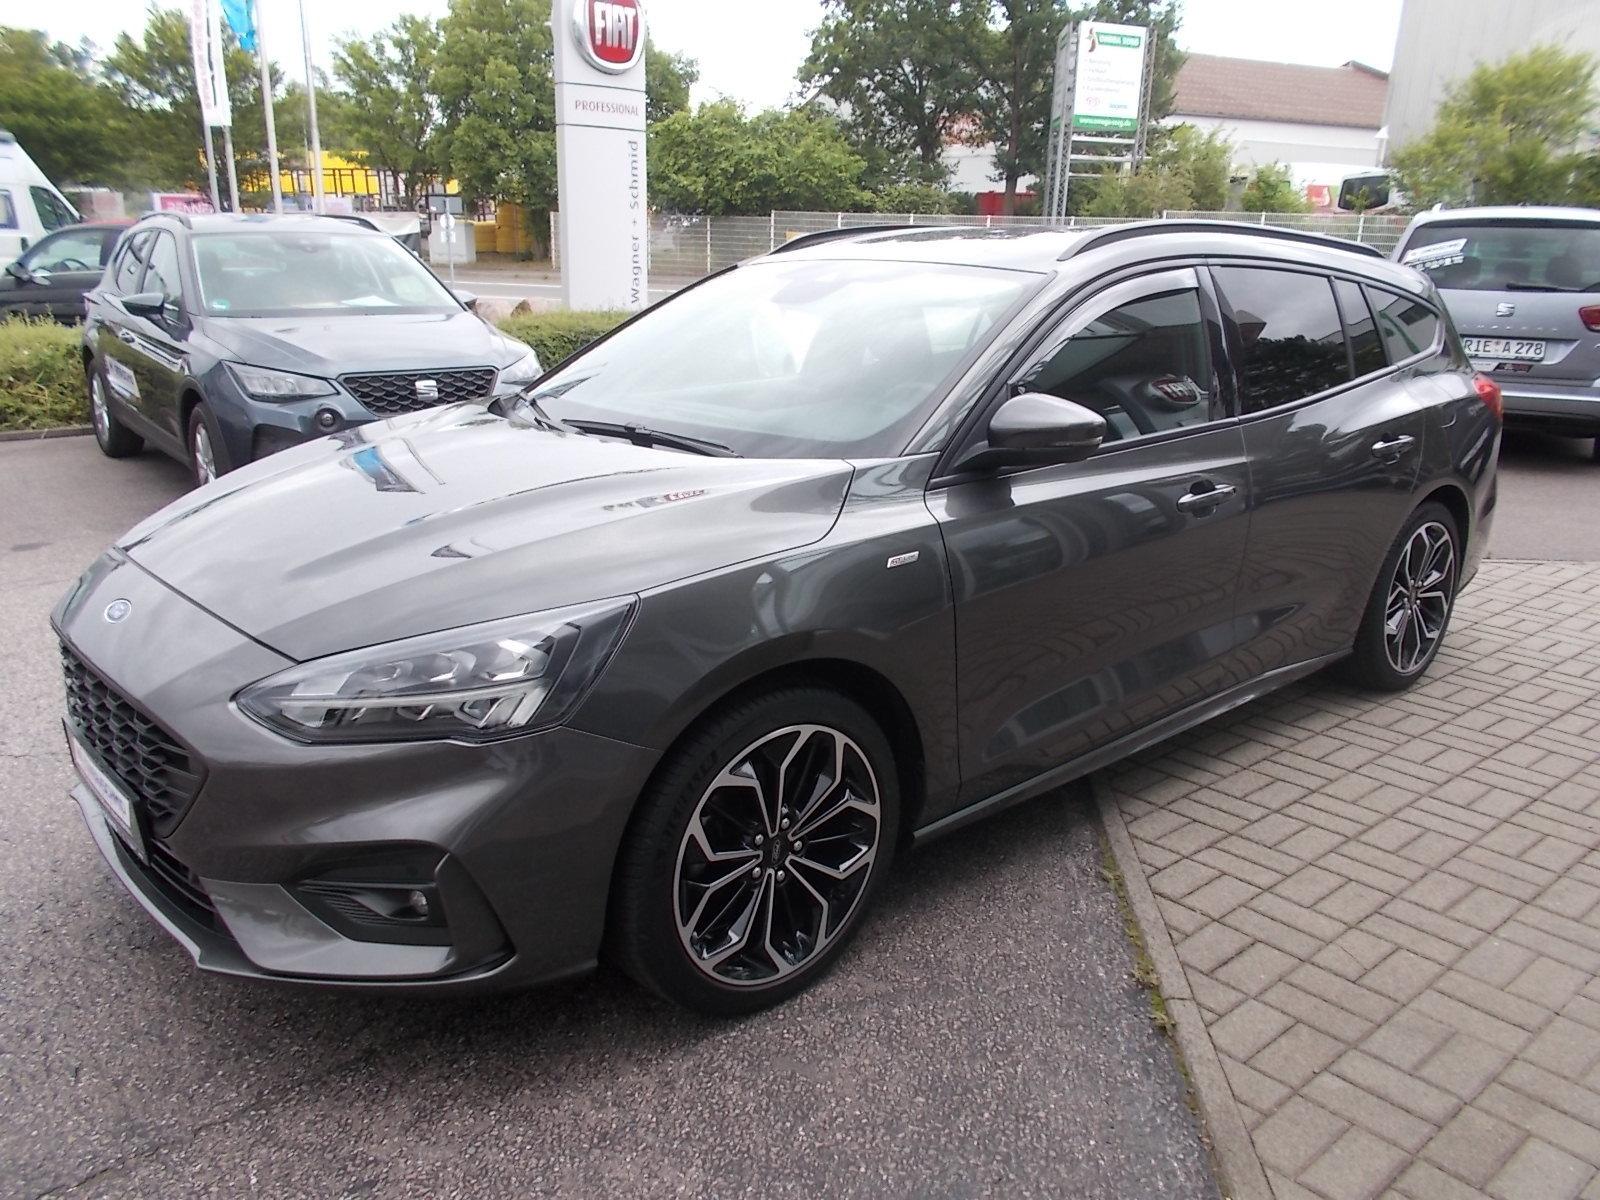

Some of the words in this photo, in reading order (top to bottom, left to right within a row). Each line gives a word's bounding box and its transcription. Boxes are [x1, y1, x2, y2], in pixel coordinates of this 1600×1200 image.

[594, 1, 636, 50] FIAT
[575, 100, 639, 116] PROFESSIONAL
[628, 140, 639, 209] Schmid
[631, 235, 642, 303] Wagner
[1464, 339, 1492, 353] RIE
[1502, 342, 1511, 353] A
[1515, 342, 1544, 356] 278
